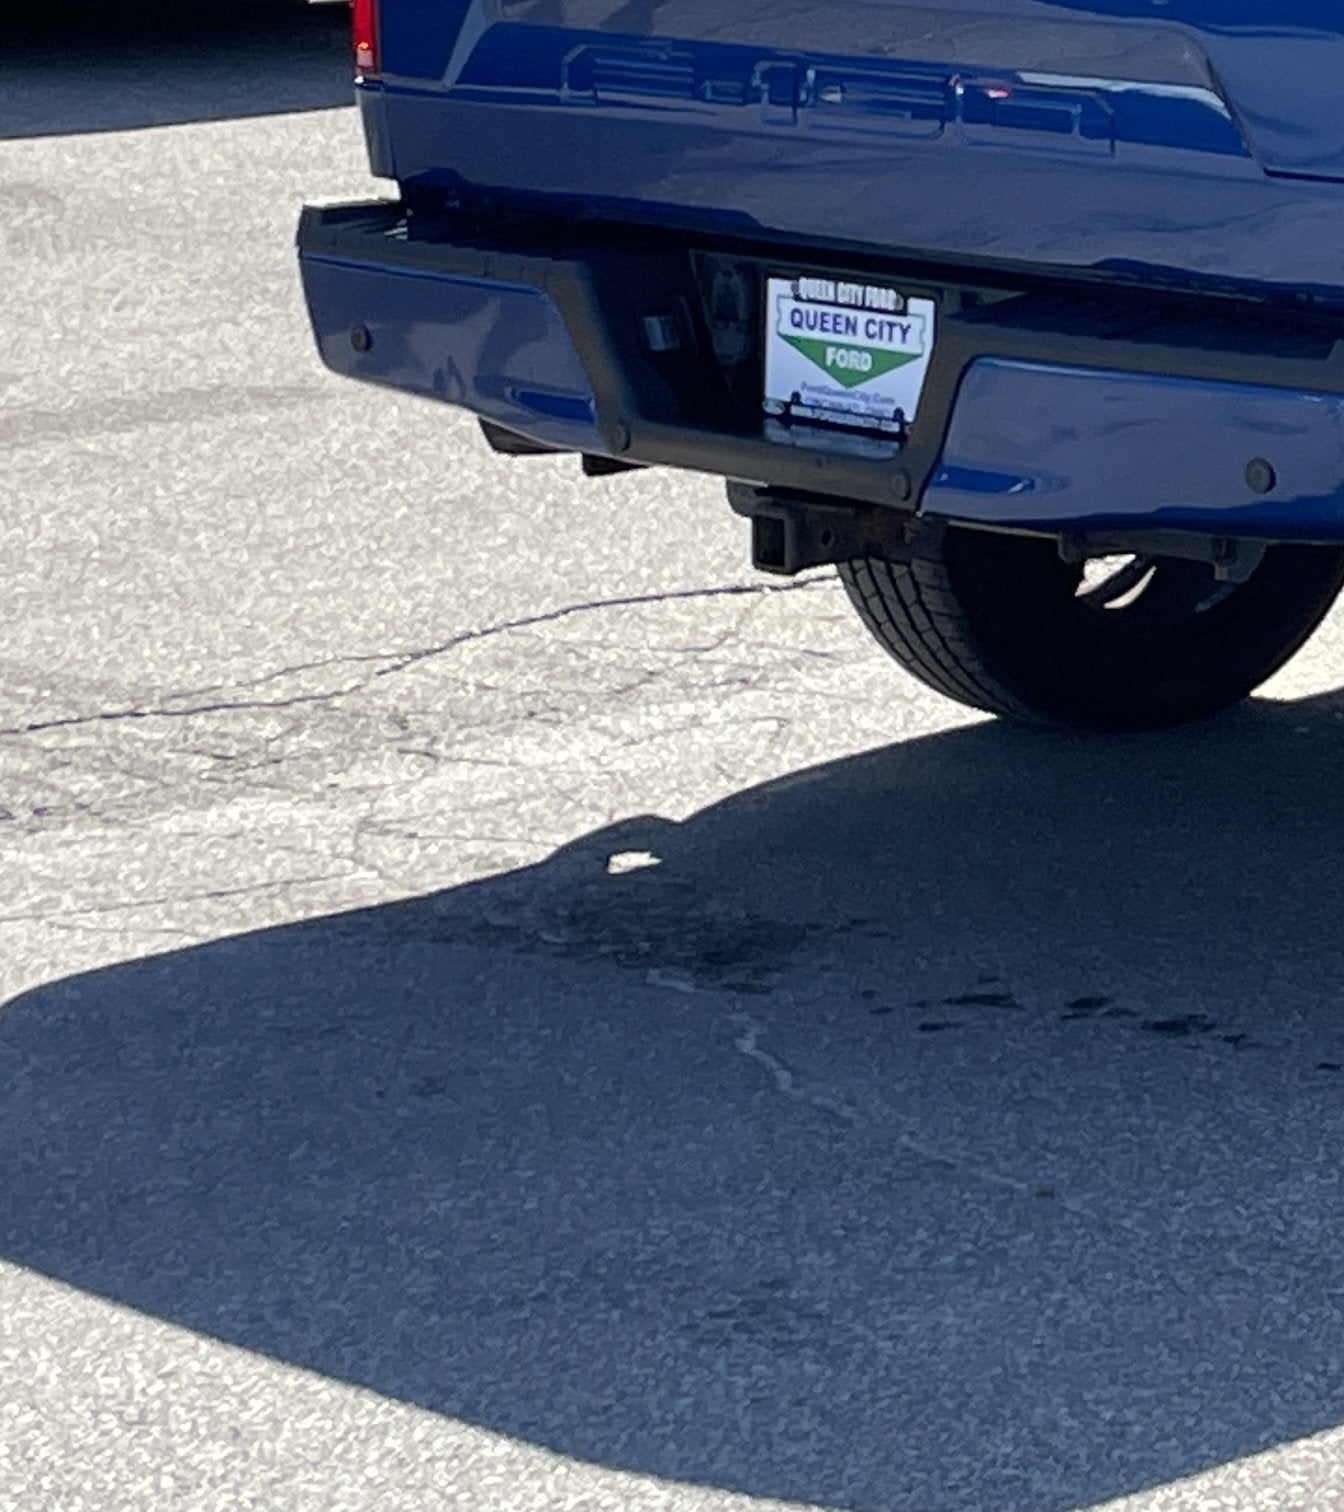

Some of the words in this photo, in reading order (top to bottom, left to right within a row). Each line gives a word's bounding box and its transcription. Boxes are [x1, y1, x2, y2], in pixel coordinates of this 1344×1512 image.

[791, 308, 858, 337] QUEEN
[865, 319, 912, 344] CITY
[825, 346, 873, 372] FORD
